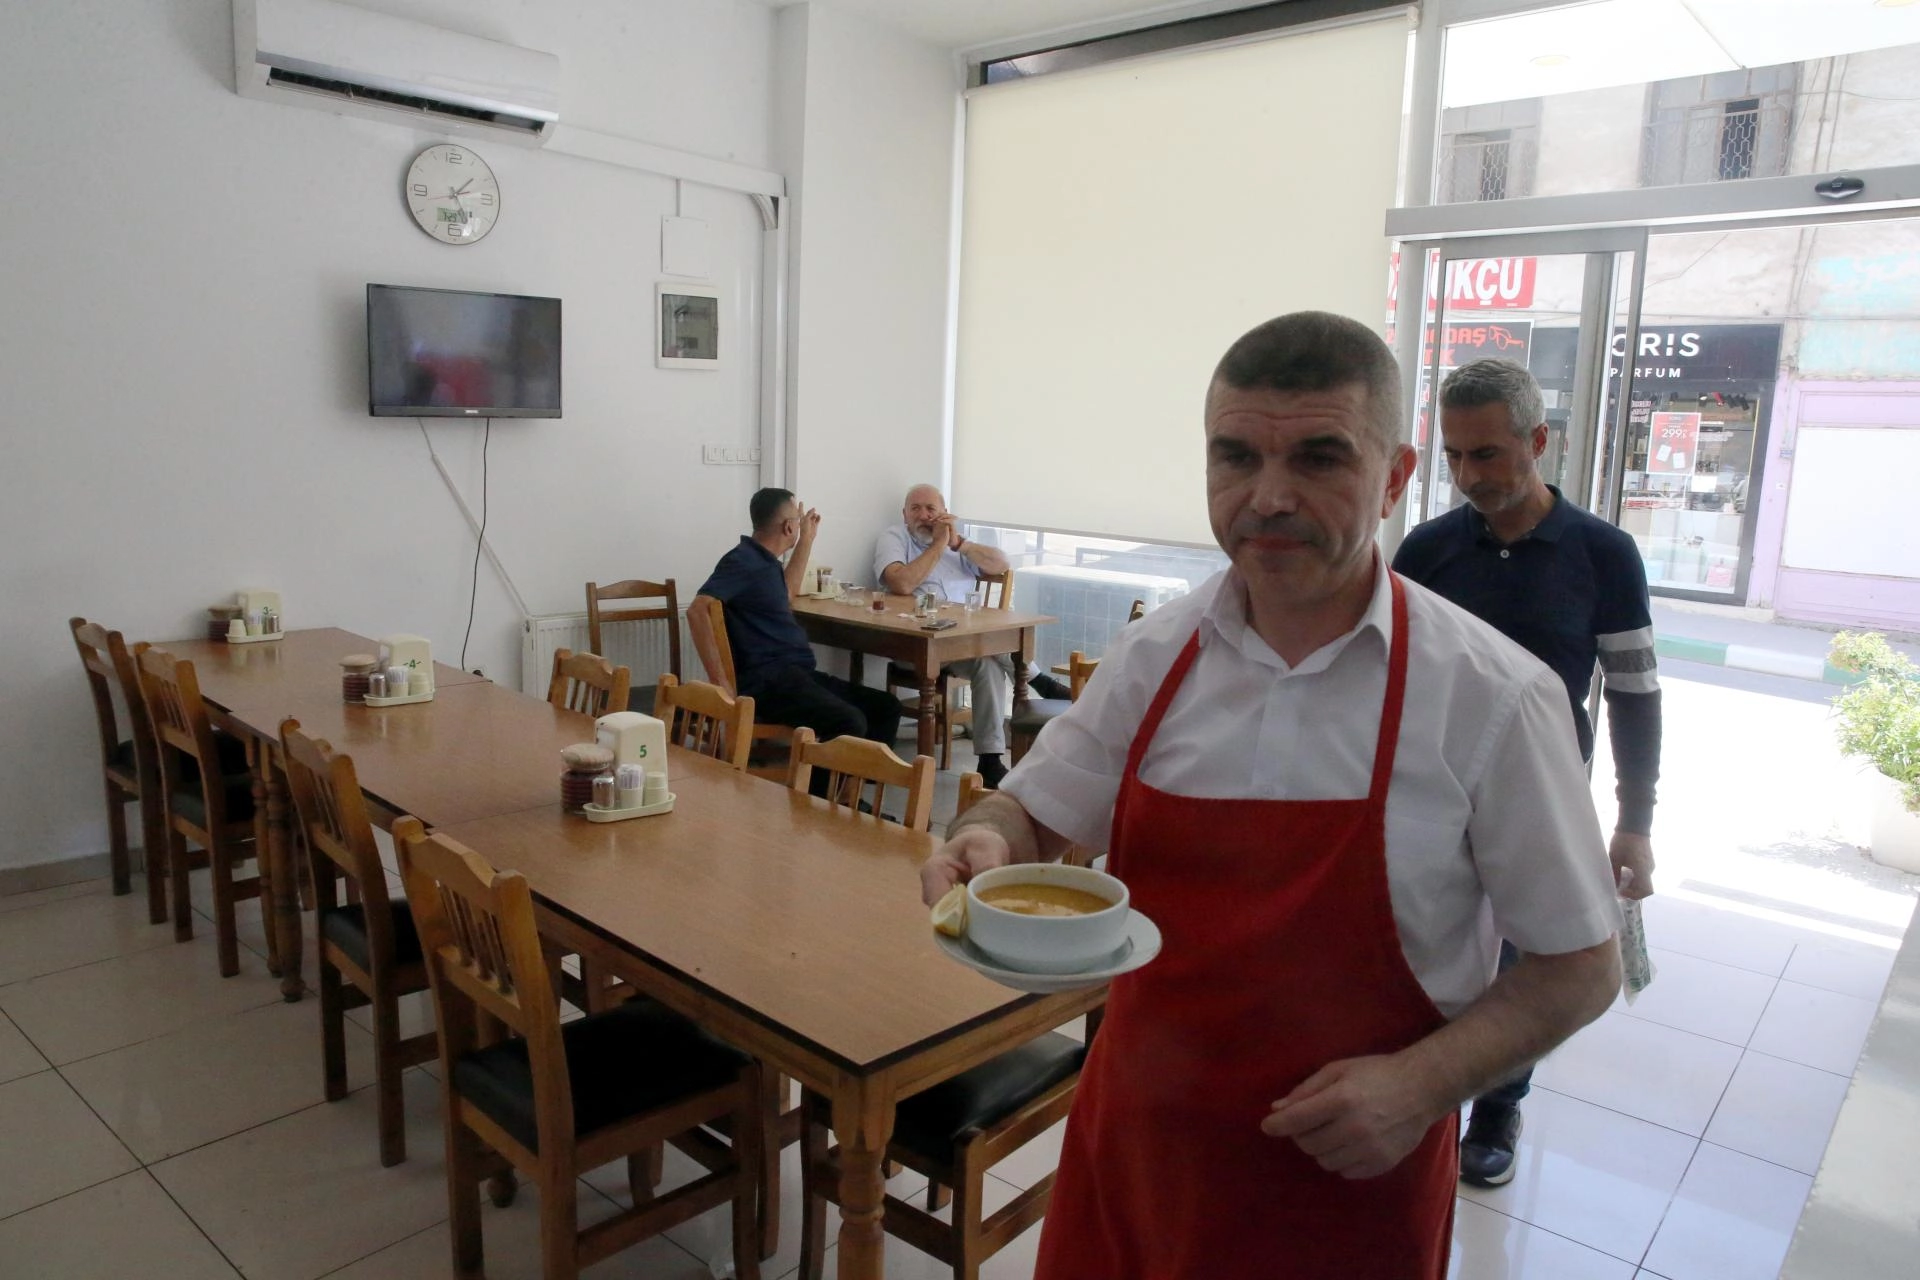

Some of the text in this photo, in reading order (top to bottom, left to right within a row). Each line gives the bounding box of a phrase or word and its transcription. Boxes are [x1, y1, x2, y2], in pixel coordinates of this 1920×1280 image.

[445, 152, 463, 165] 12
[413, 184, 428, 197] 9
[480, 193, 494, 206] 3
[447, 223, 462, 238] 6
[1609, 367, 1682, 378] PRFUM
[639, 744, 648, 758] 5
